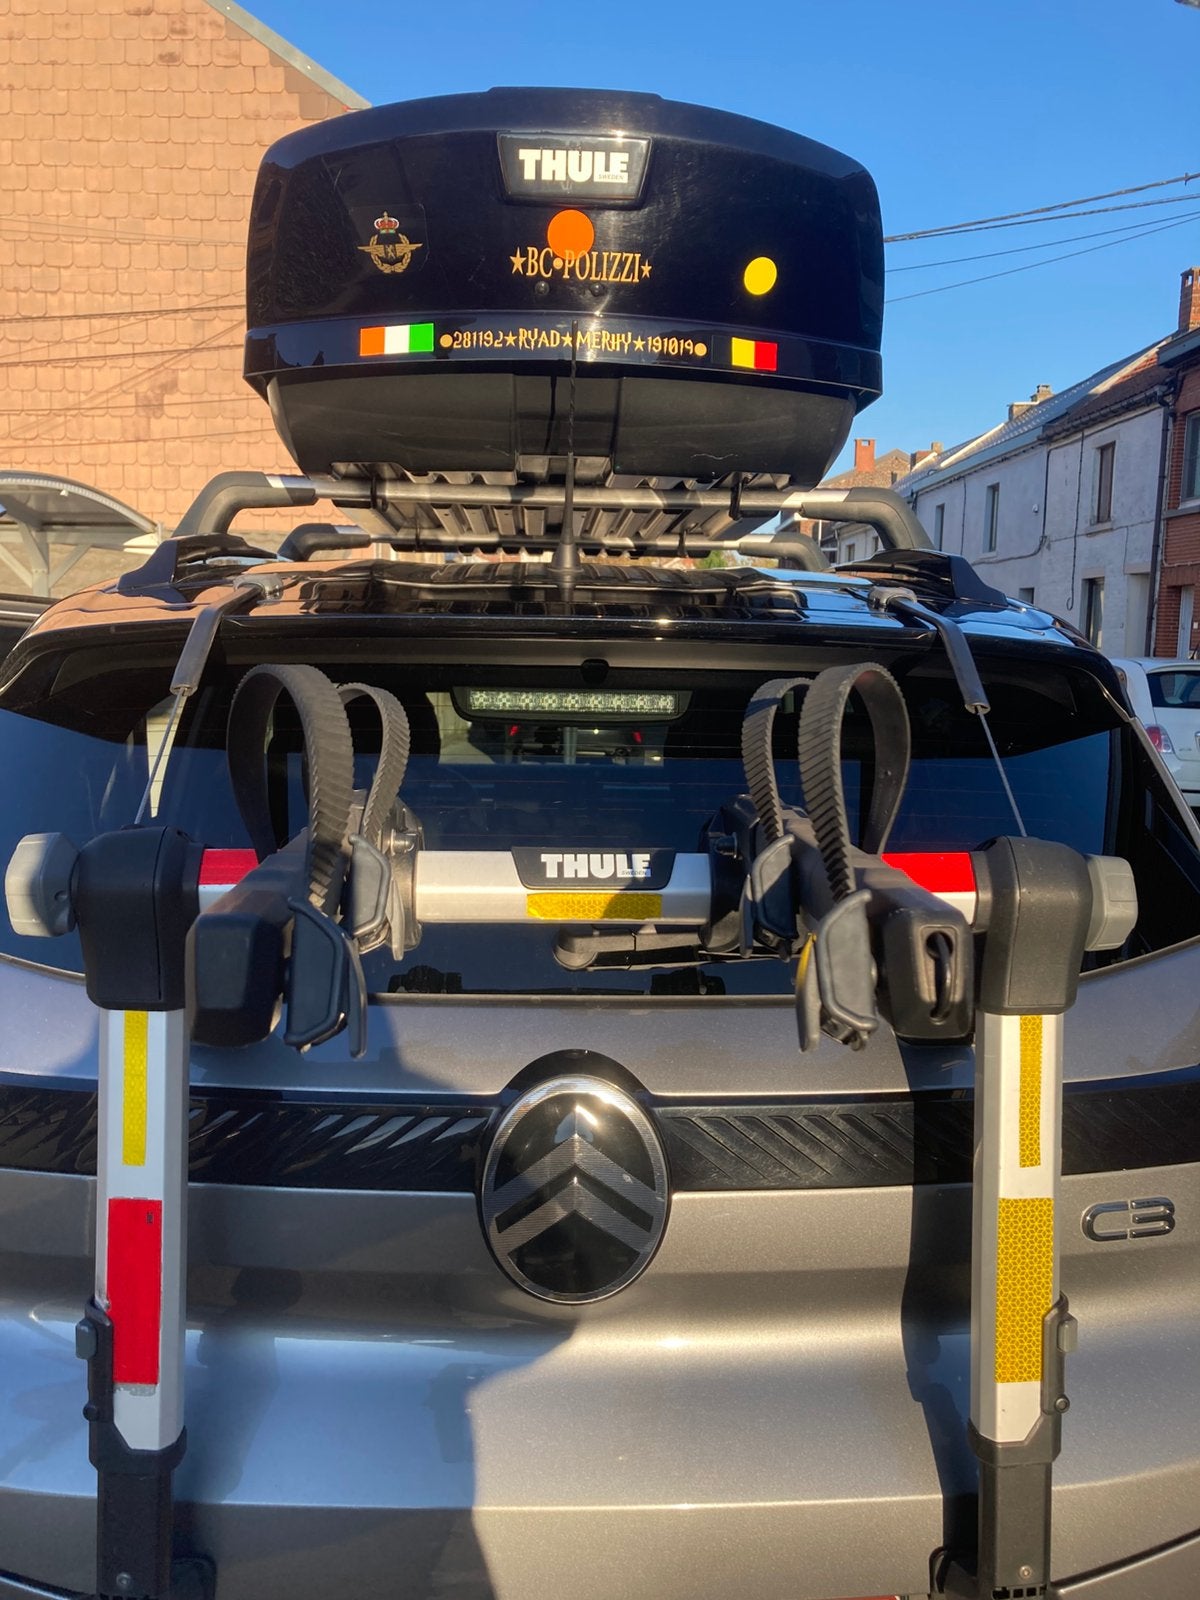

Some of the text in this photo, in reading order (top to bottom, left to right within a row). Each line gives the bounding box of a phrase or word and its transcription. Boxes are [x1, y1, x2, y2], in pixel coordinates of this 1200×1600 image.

[518, 148, 629, 183] THULE
[598, 173, 624, 181] SWEDEN
[526, 246, 641, 283] BC POLIZZI
[453, 327, 694, 356] 281192 RYAD MERHY 191019
[540, 853, 652, 879] THULE
[1081, 1195, 1176, 1242] C3
